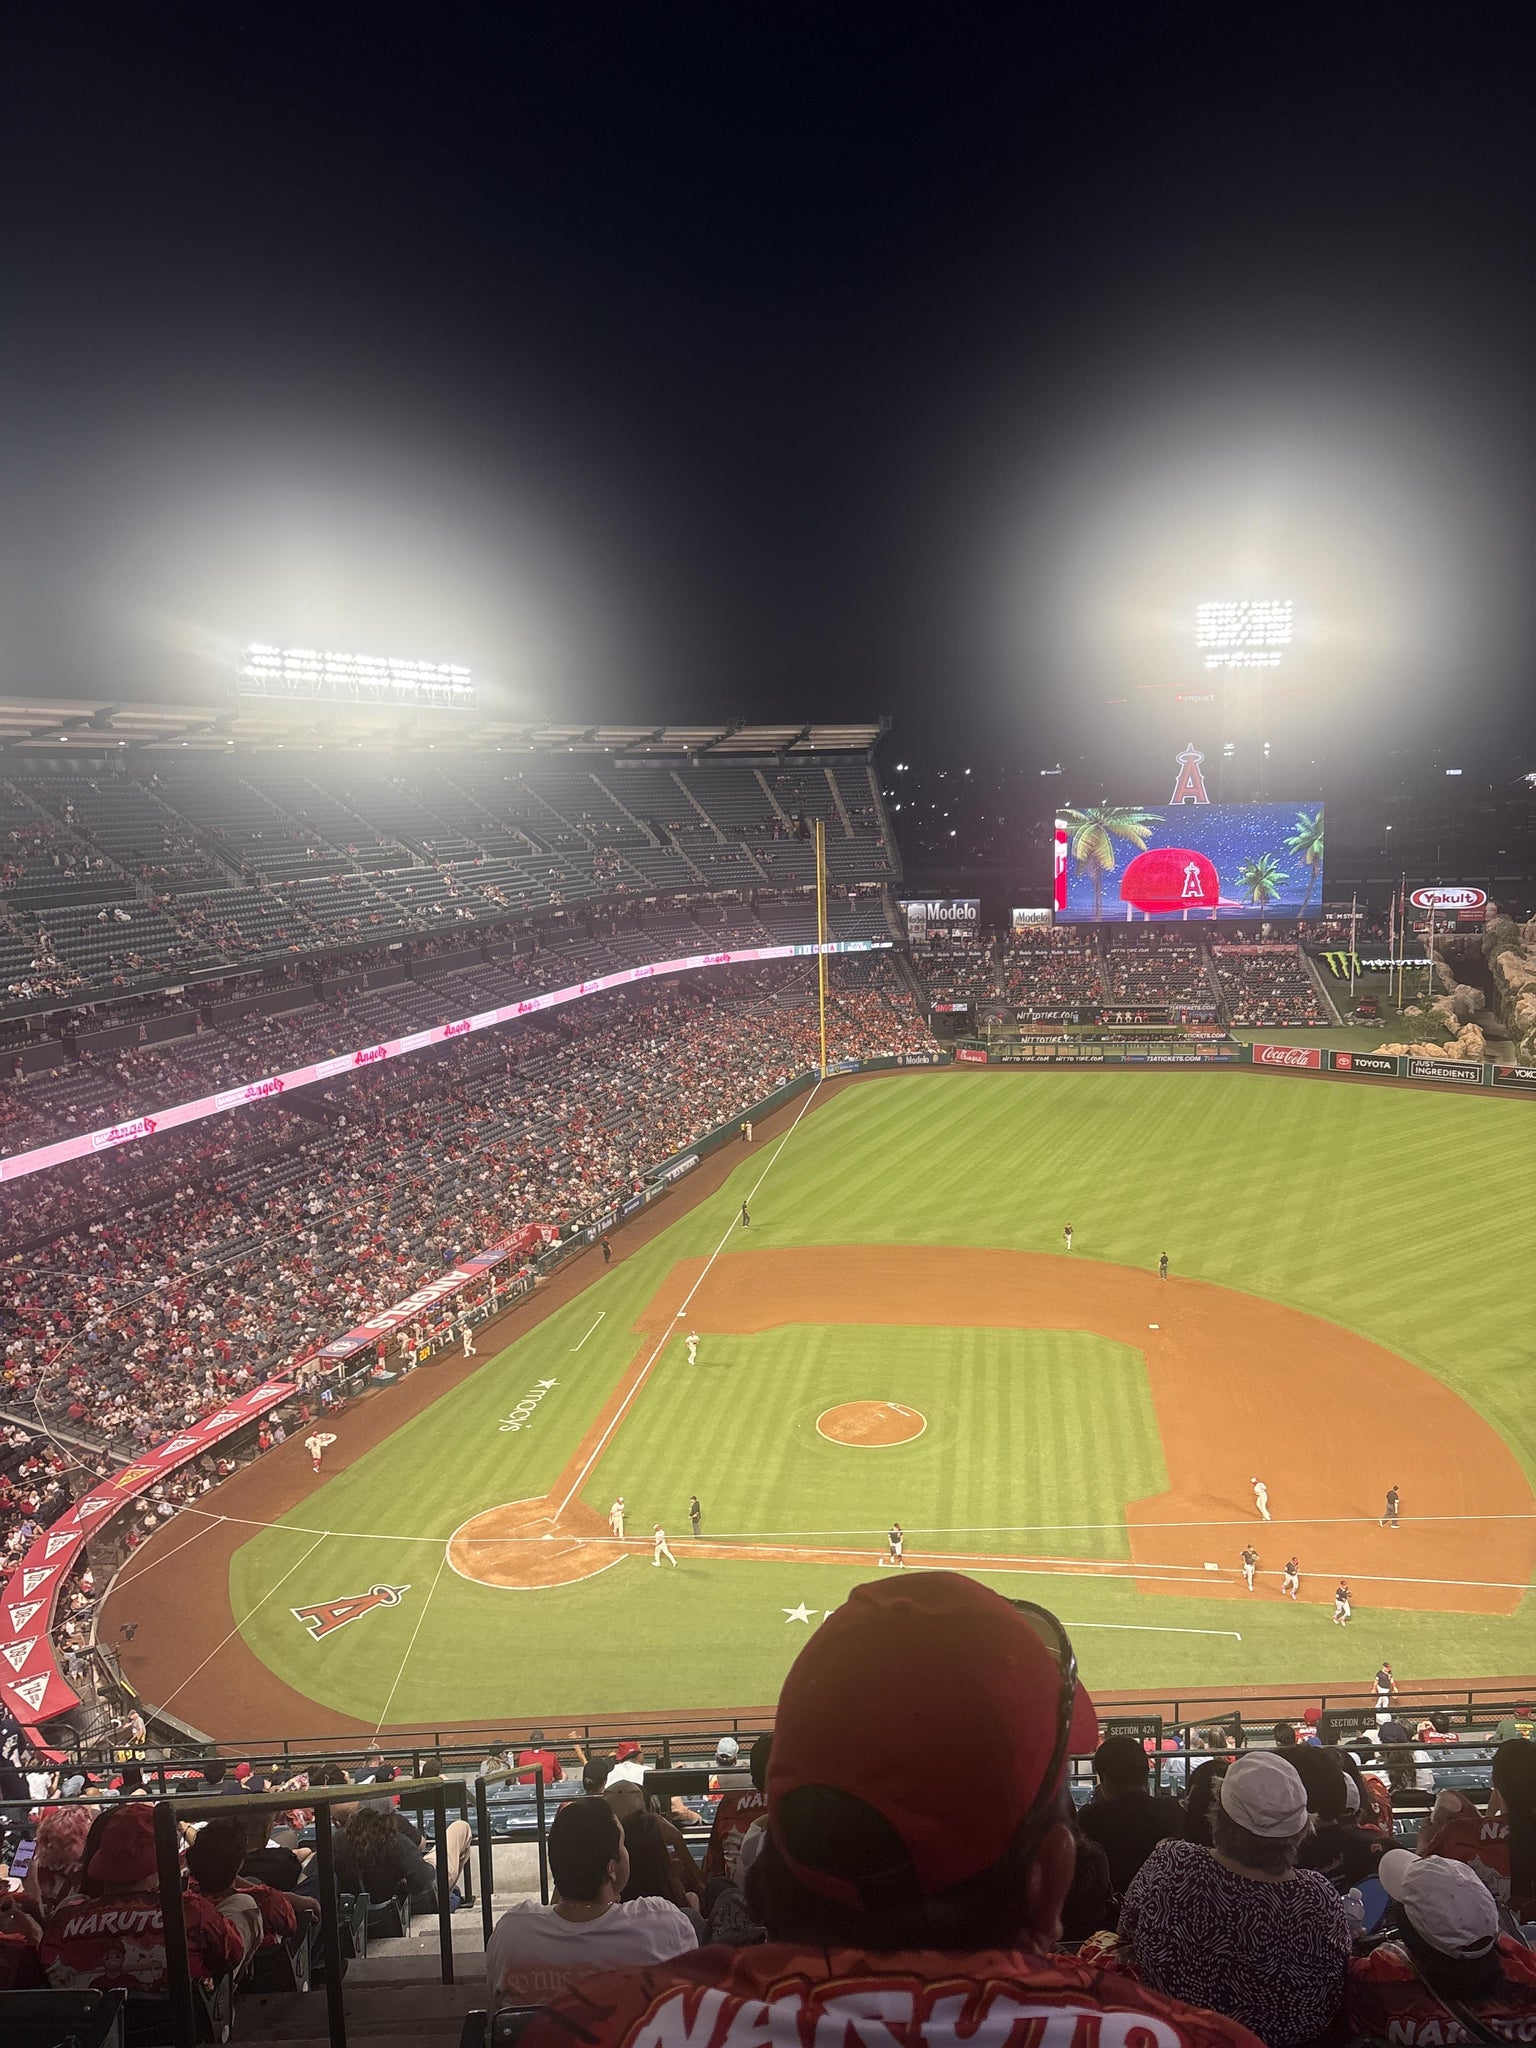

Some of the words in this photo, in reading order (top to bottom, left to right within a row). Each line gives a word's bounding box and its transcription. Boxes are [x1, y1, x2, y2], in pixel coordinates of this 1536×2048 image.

[1423, 893, 1475, 904] Yakult
[927, 902, 977, 921] Modelo
[1016, 910, 1048, 923] Modelo
[905, 1054, 930, 1064] Modelo
[1261, 1046, 1310, 1066] Coca-Cola
[1354, 1058, 1392, 1070] TOYOTA
[1414, 1060, 1435, 1068] JUST
[1414, 1067, 1476, 1080] INGREDIENTS
[363, 1270, 472, 1330] ANGELS
[1329, 1717, 1359, 1728] SECTION
[1361, 1717, 1375, 1727] 425
[1110, 1726, 1139, 1737] SECTION
[1142, 1725, 1155, 1735] 424
[62, 1909, 164, 1940] NARUTO
[1387, 2019, 1536, 2048] NARTO
